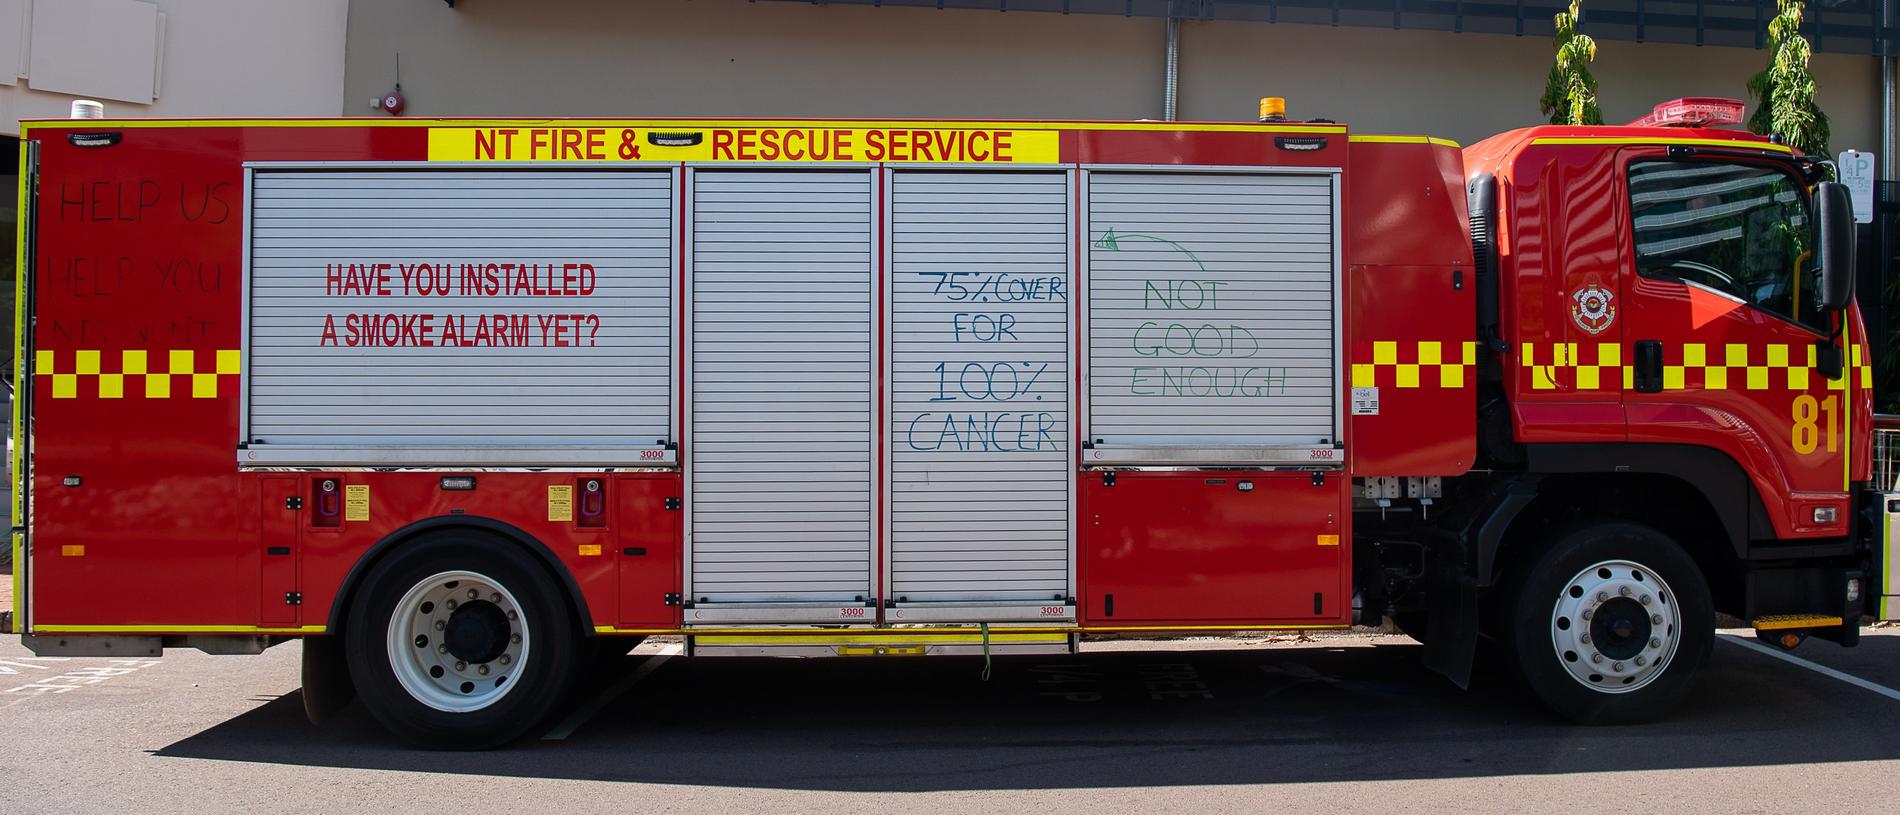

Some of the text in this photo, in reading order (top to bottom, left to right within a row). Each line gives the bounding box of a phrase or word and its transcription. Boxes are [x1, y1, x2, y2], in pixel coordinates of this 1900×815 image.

[474, 129, 1013, 163] NT FIRE & RESCUE SERVICE
[60, 180, 230, 225] HELP US
[46, 256, 222, 298] HELP YOU
[326, 262, 596, 296] HAVE YOU INSTALLED
[1144, 279, 1229, 311] NOT
[320, 313, 600, 347] A SMOKE ALARM YET?
[953, 312, 1019, 343] FOR
[1132, 321, 1259, 359] GOOD
[929, 361, 1048, 402] 100%
[1130, 366, 1287, 398] ENOUGH
[908, 411, 1058, 452] CANCER
[1791, 393, 1838, 455] 81
[640, 450, 664, 458] 3000
[1310, 449, 1333, 457] 3000
[840, 607, 864, 615] 3000
[1040, 606, 1064, 614] 3000
